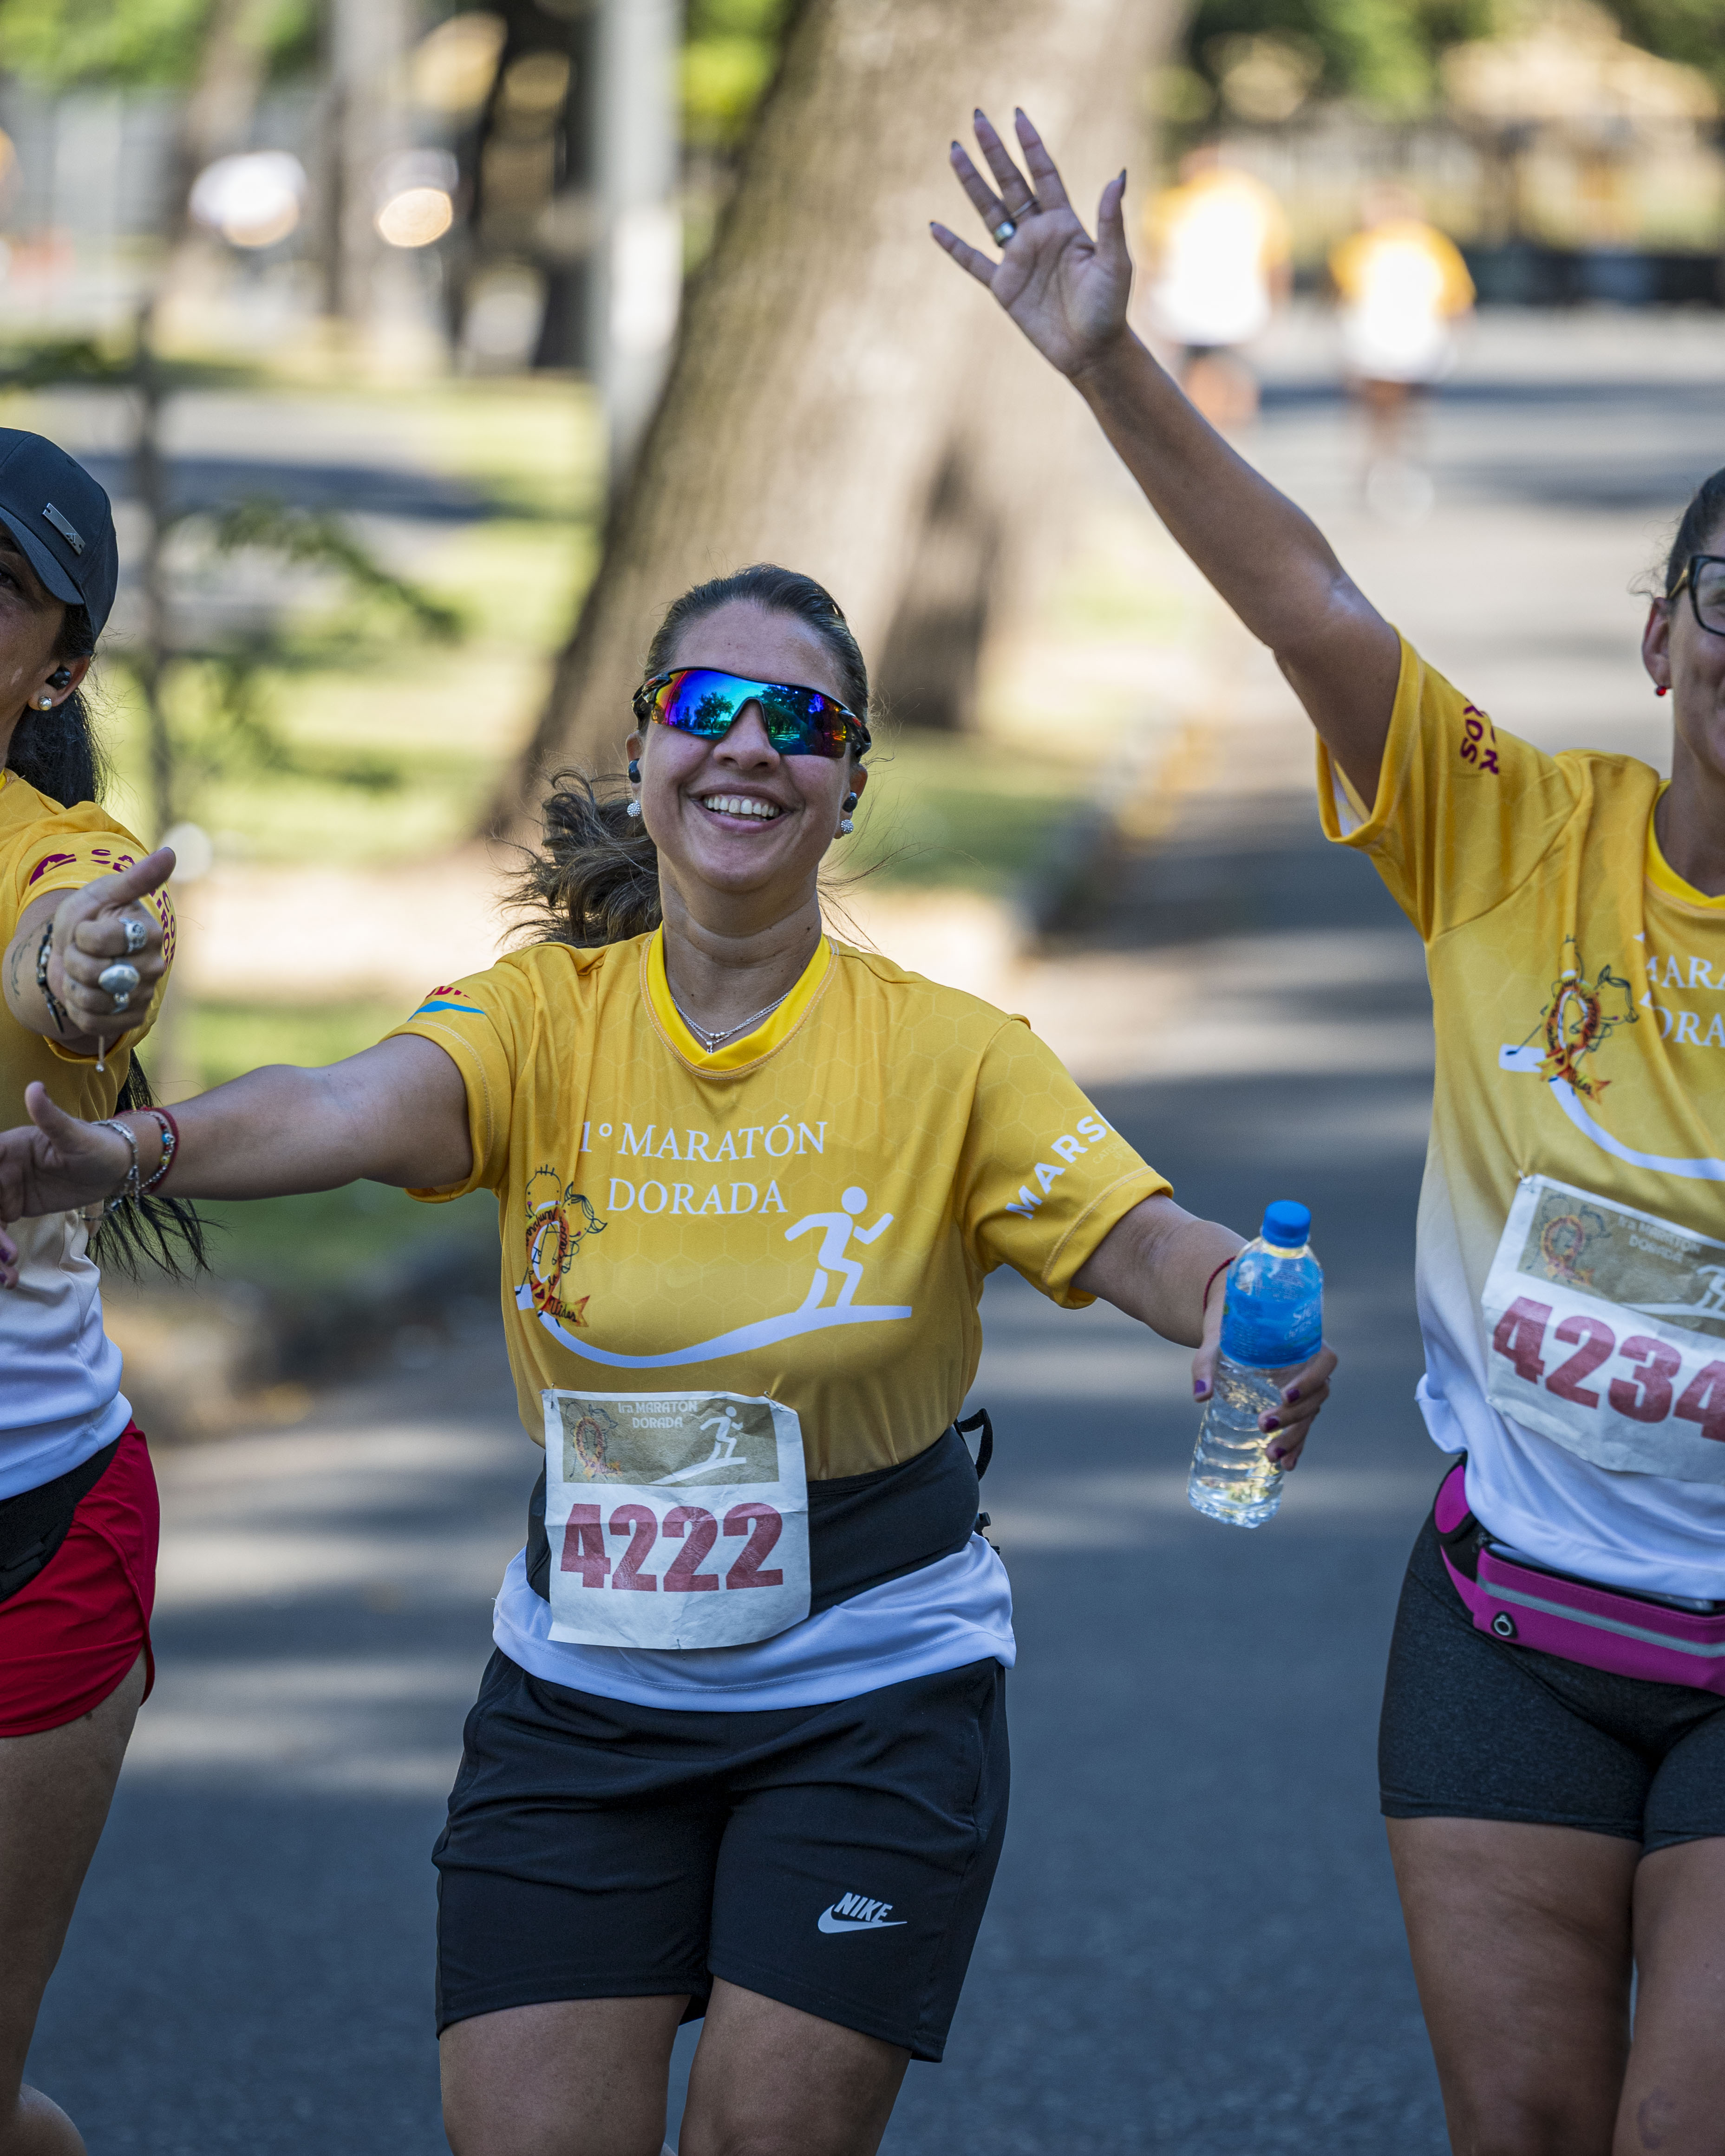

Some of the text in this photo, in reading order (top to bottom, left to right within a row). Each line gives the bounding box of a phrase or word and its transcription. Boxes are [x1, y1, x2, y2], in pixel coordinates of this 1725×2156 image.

[617, 1114, 828, 1162] MARATÓN
[1005, 1109, 1115, 1219] MARS
[607, 1178, 788, 1214] DORADA
[1493, 1296, 1725, 1442] 4234
[632, 1417, 683, 1428] DORADA
[561, 1502, 784, 1592] 4222
[834, 1892, 893, 1922] NIKE
